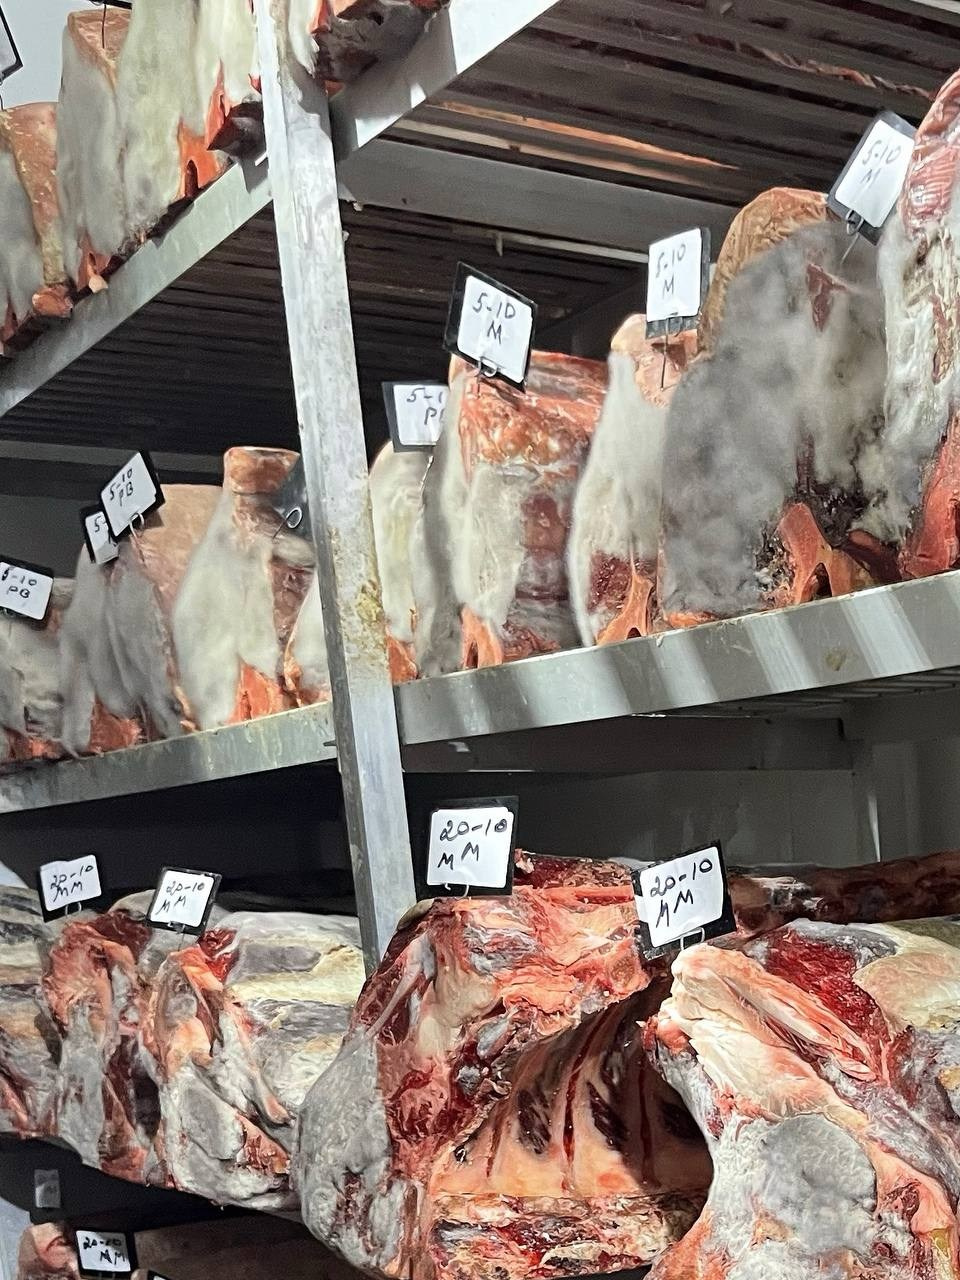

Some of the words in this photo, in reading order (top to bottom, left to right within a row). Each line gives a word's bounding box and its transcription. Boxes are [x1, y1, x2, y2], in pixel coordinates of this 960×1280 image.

[656, 243, 686, 278] 5-10
[663, 278, 674, 299] M
[472, 292, 516, 320] 5-10
[487, 324, 502, 346] M
[109, 467, 133, 501] 5-10
[440, 818, 508, 841] 20-10
[650, 858, 713, 896] 20-10
